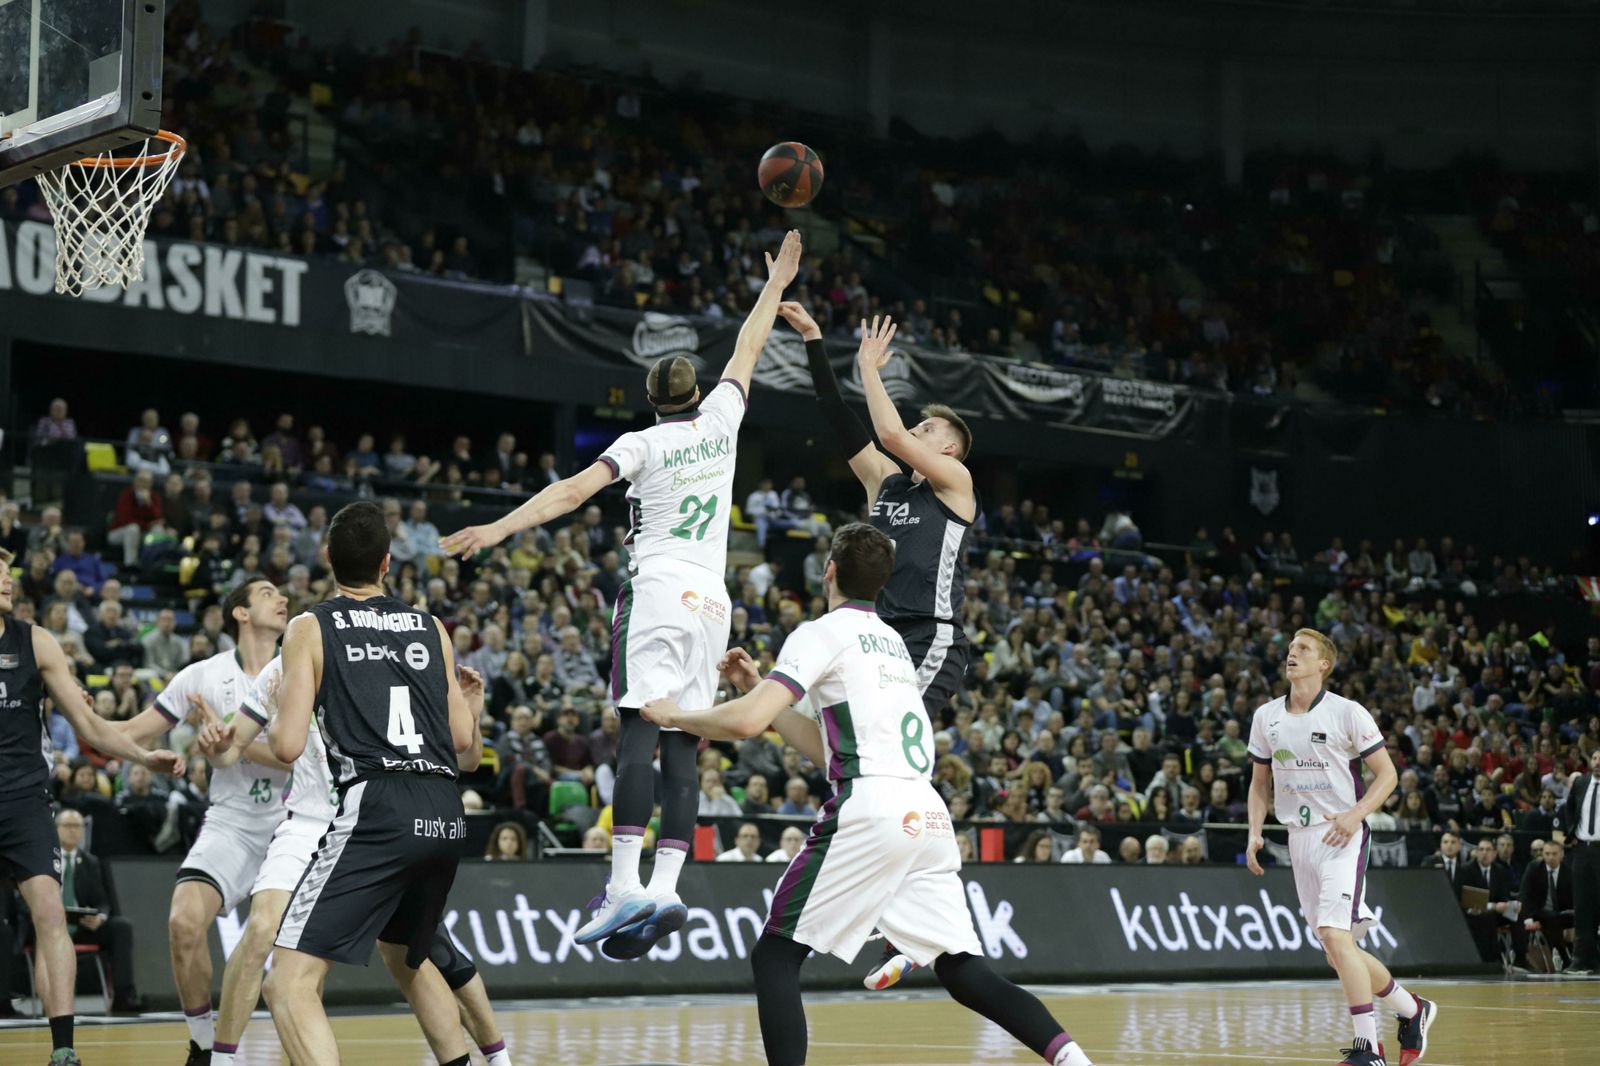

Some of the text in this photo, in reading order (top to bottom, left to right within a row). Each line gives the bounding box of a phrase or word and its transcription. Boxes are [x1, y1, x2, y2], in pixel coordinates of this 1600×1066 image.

[79, 231, 308, 327] BASKET
[669, 494, 718, 541] 21
[331, 611, 350, 630] S.
[345, 643, 400, 663] bbk
[386, 685, 424, 754] 4
[901, 711, 930, 774] 8
[1296, 758, 1329, 769] Unicaja
[249, 778, 272, 804] 43
[1299, 805, 1311, 827] 9
